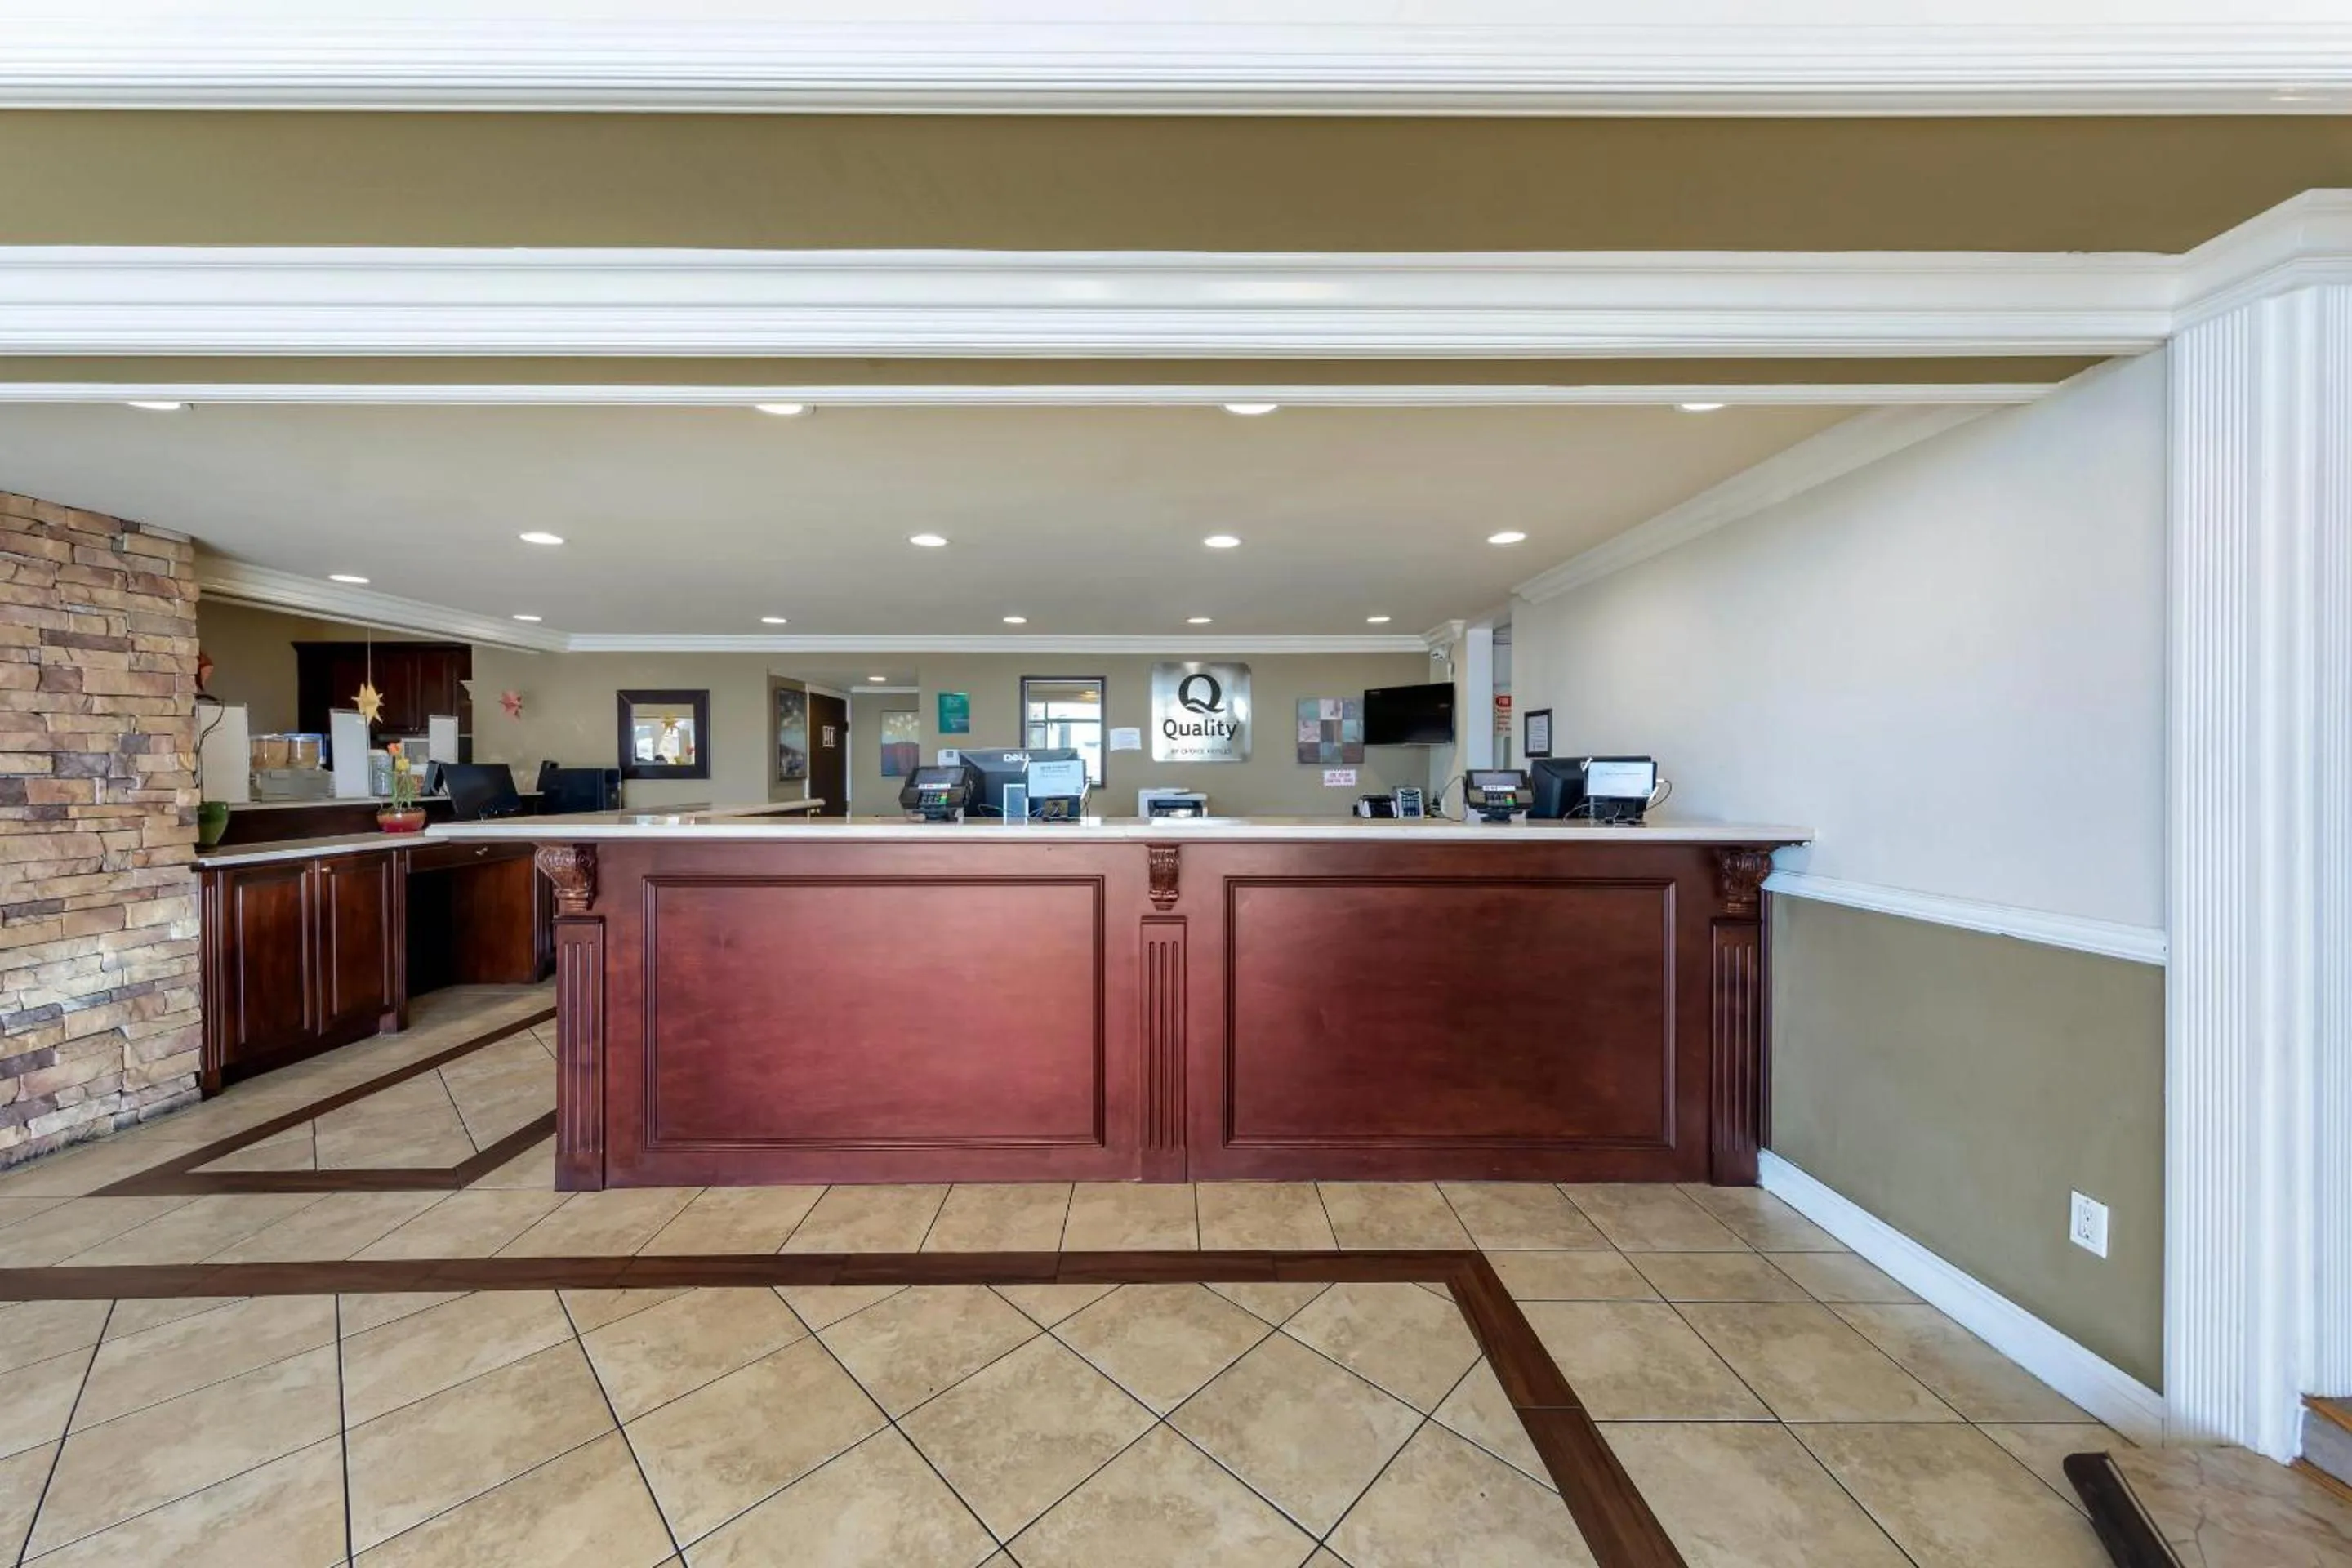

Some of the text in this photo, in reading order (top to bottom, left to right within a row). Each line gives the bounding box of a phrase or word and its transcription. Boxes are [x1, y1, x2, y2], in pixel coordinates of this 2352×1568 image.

[1178, 674, 1225, 714] Q
[1163, 719, 1238, 741] Quality
[1004, 752, 1031, 763] DELL
